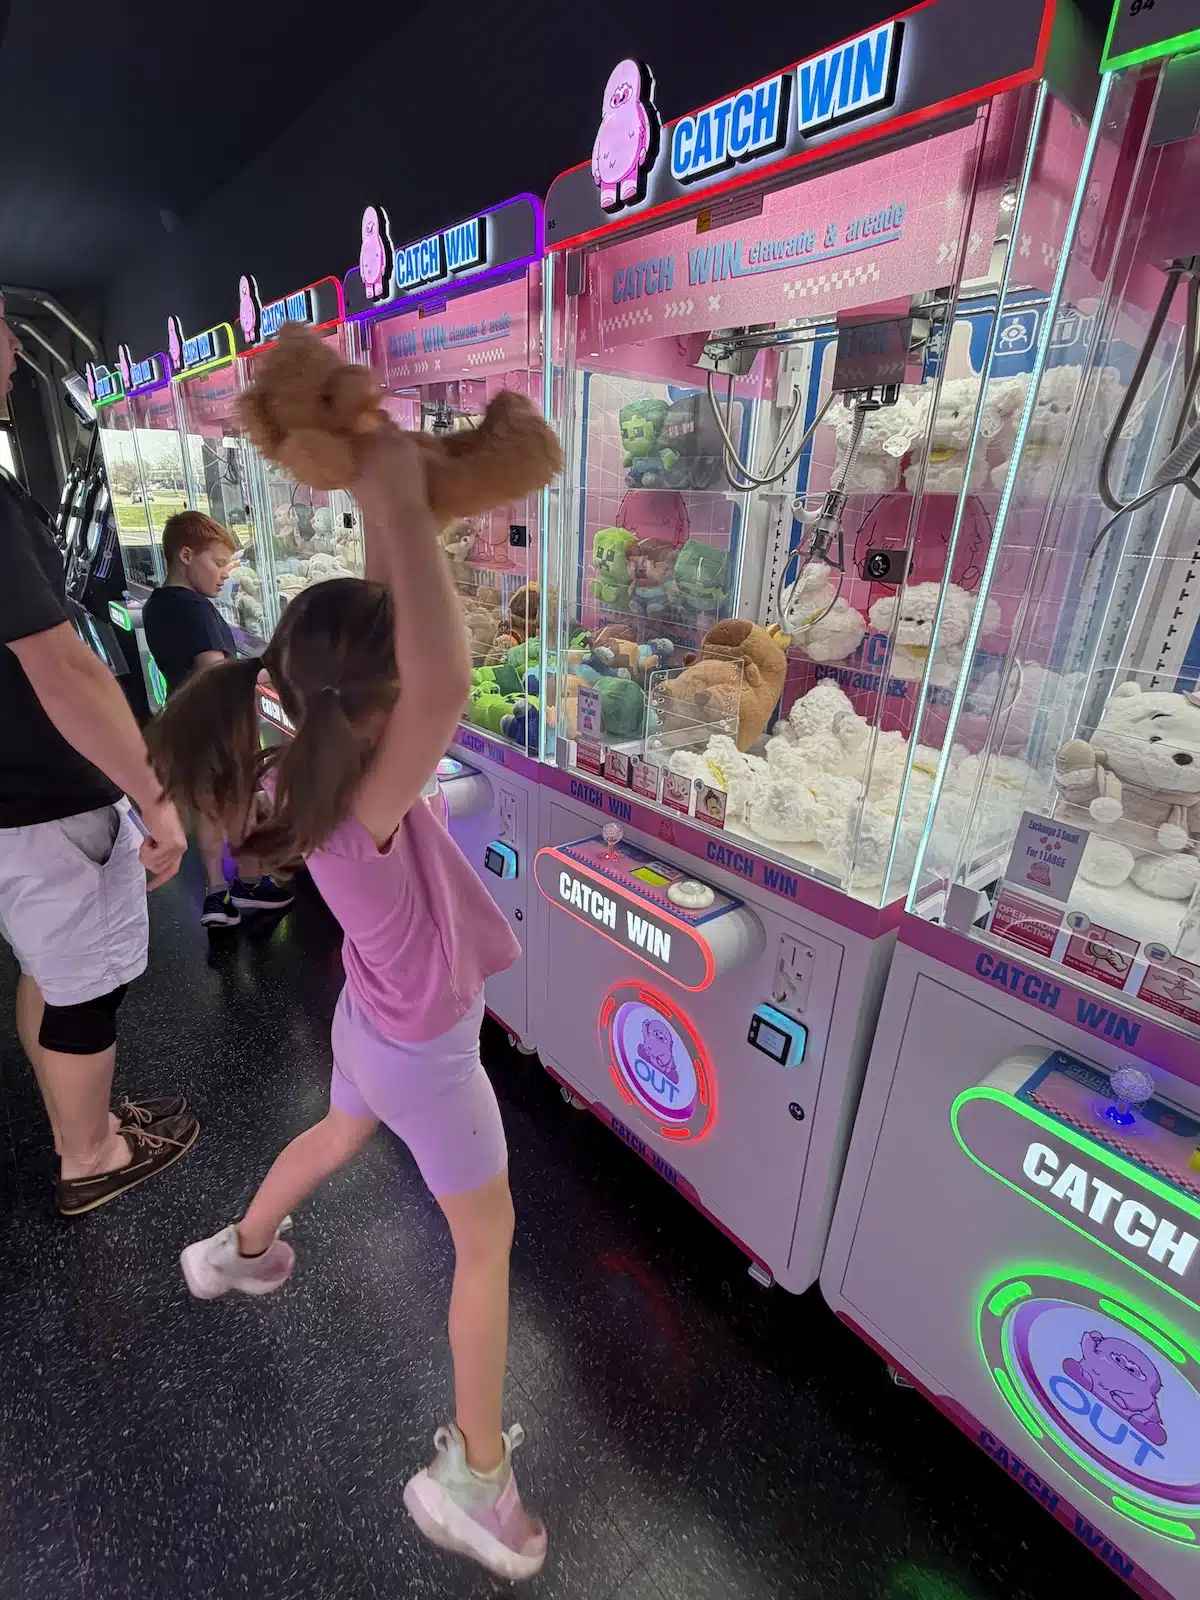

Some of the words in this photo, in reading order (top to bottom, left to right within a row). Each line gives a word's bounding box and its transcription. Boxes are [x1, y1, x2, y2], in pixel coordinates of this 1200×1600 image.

[673, 80, 779, 174] CATCH
[800, 29, 889, 125] WIN
[395, 236, 439, 286] CATCH
[444, 220, 478, 269] WIN
[612, 254, 675, 304] CATCH
[688, 238, 745, 286] WIN
[748, 227, 816, 266] clawade
[824, 220, 837, 248] &
[845, 201, 907, 243] arcade
[261, 300, 285, 336] CATCH
[287, 291, 307, 321] WIN
[421, 322, 448, 353] WIN
[460, 731, 485, 754] CATCH
[487, 743, 505, 763] WIN
[570, 779, 603, 808] CATCH
[608, 796, 632, 821] WIN
[1026, 846, 1037, 858] For
[1043, 852, 1067, 868] LARGE
[1028, 819, 1057, 837] Exchange
[1061, 830, 1080, 845] Small
[706, 841, 754, 878] CATCH
[763, 866, 798, 898] WIN
[559, 871, 617, 930] CATCH
[626, 910, 672, 964] WIN
[995, 912, 1055, 941] INSTRUCTION
[998, 904, 1057, 934] OPERATION
[975, 952, 1062, 1010] CATCH
[1076, 997, 1142, 1047] WIN
[634, 1058, 680, 1103] OUT
[611, 1116, 647, 1157] CATCH
[651, 1153, 678, 1187] WIN
[1022, 1142, 1200, 1277] CATCH
[1049, 1375, 1165, 1467] OUT
[978, 1430, 1060, 1511] CATCH
[1073, 1514, 1135, 1580] WIN
